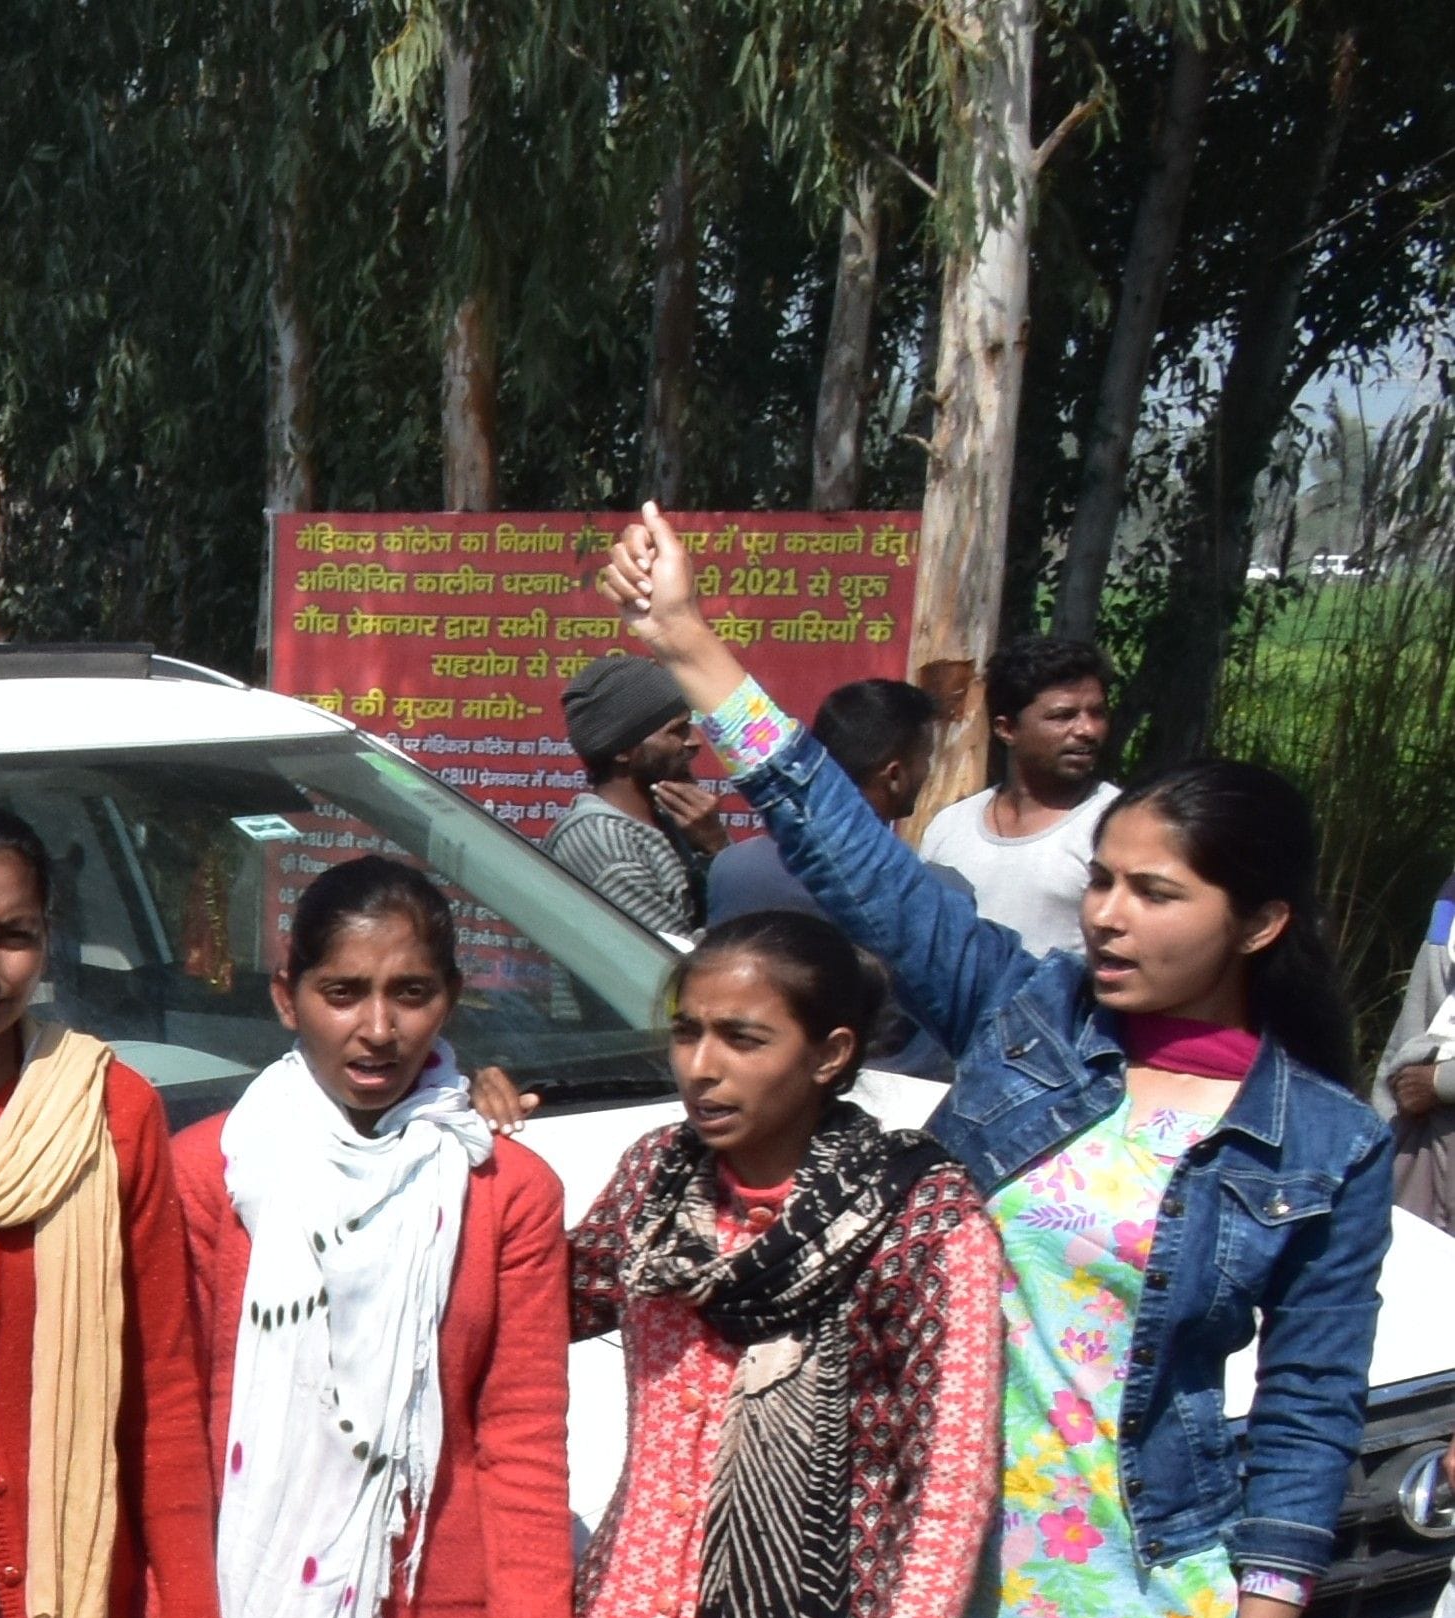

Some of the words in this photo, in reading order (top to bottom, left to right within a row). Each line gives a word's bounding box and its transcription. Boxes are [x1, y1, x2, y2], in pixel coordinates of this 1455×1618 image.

[382, 525, 453, 554] कॉलेज
[459, 531, 489, 553] का
[495, 523, 566, 553] निर्माण
[741, 531, 779, 566] पूरा
[784, 524, 865, 553] करवाने
[413, 564, 495, 594] कालीन
[728, 567, 799, 596] 2021
[807, 566, 832, 597] से
[345, 606, 440, 639] प्रेमनगर
[498, 607, 550, 638] सभी
[555, 616, 621, 641] हल्का
[865, 611, 896, 643] के
[431, 648, 520, 679] सहयोग
[525, 648, 551, 678] से
[351, 687, 386, 716] की
[392, 697, 455, 729] मुख्य
[440, 768, 477, 785] CBLU
